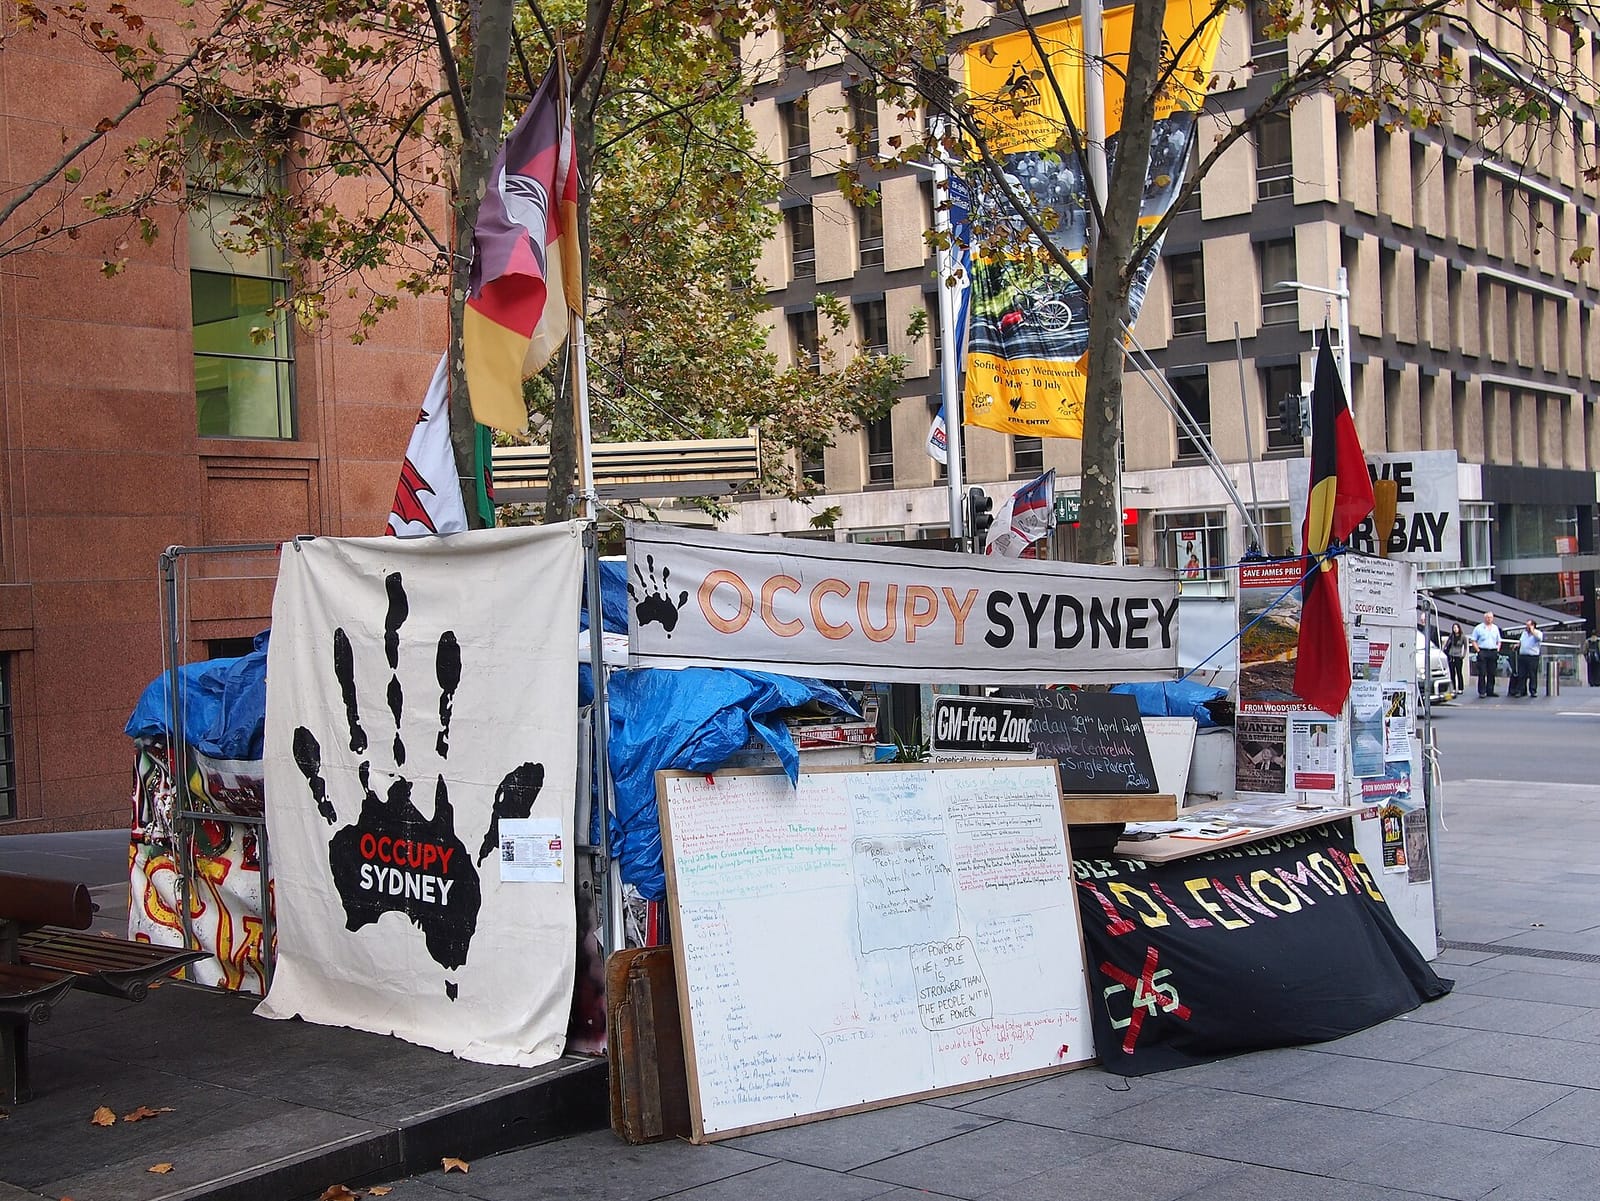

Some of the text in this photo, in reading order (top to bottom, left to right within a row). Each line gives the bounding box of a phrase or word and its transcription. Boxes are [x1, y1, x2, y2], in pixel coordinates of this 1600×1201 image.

[974, 360, 1081, 378] Sofitel Sydney Wentworth
[1005, 380, 1023, 390] May
[1033, 378, 1042, 388] 10
[1044, 380, 1062, 391] July
[1020, 401, 1037, 410] SBS
[1026, 417, 1050, 425] ENTRY
[1367, 462, 1415, 503] VE
[1067, 500, 1081, 512] Mar
[1388, 511, 1449, 553] BAY
[1243, 569, 1261, 578] SAVE
[1261, 567, 1284, 577] JAMES
[697, 568, 979, 647] OCCUPY
[1355, 603, 1394, 615] OCCUPY SYDNEY
[985, 590, 1179, 650] SYDNEY
[1245, 703, 1264, 712] FROM
[1264, 703, 1307, 712] WOODSIDE'S
[937, 705, 997, 742] GM-free
[1097, 717, 1119, 742] April
[1082, 737, 1135, 757] Centrelink
[1067, 756, 1103, 780] Single
[1103, 756, 1137, 775] Parent
[360, 833, 454, 874] OCCUPY
[360, 863, 455, 906] SYDNEY
[928, 939, 966, 957] POWER OF
[919, 975, 982, 1000] STRONGER THAN
[934, 970, 947, 984] IS
[917, 988, 989, 1015] THE PEOPLE WITH
[929, 1005, 977, 1027] THE POWER
